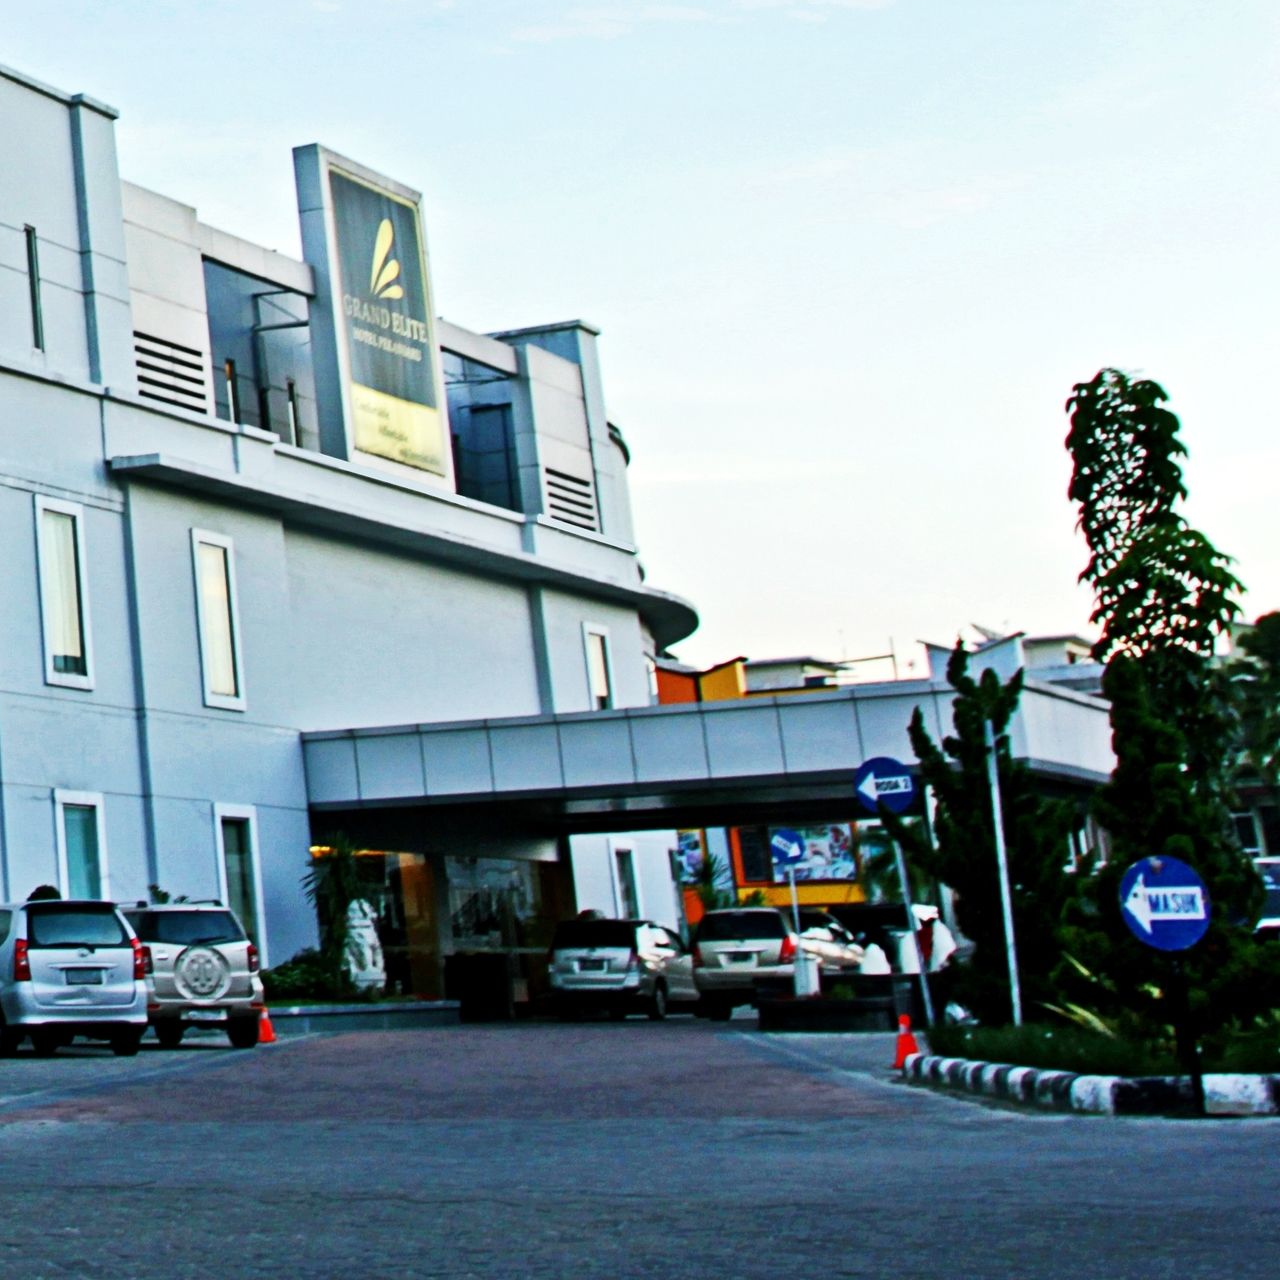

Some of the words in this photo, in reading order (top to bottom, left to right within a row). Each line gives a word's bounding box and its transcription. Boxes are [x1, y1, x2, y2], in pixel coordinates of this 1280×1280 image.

[344, 293, 390, 329] GRAND
[392, 312, 427, 343] ELITE
[1147, 892, 1200, 914] MASUK
